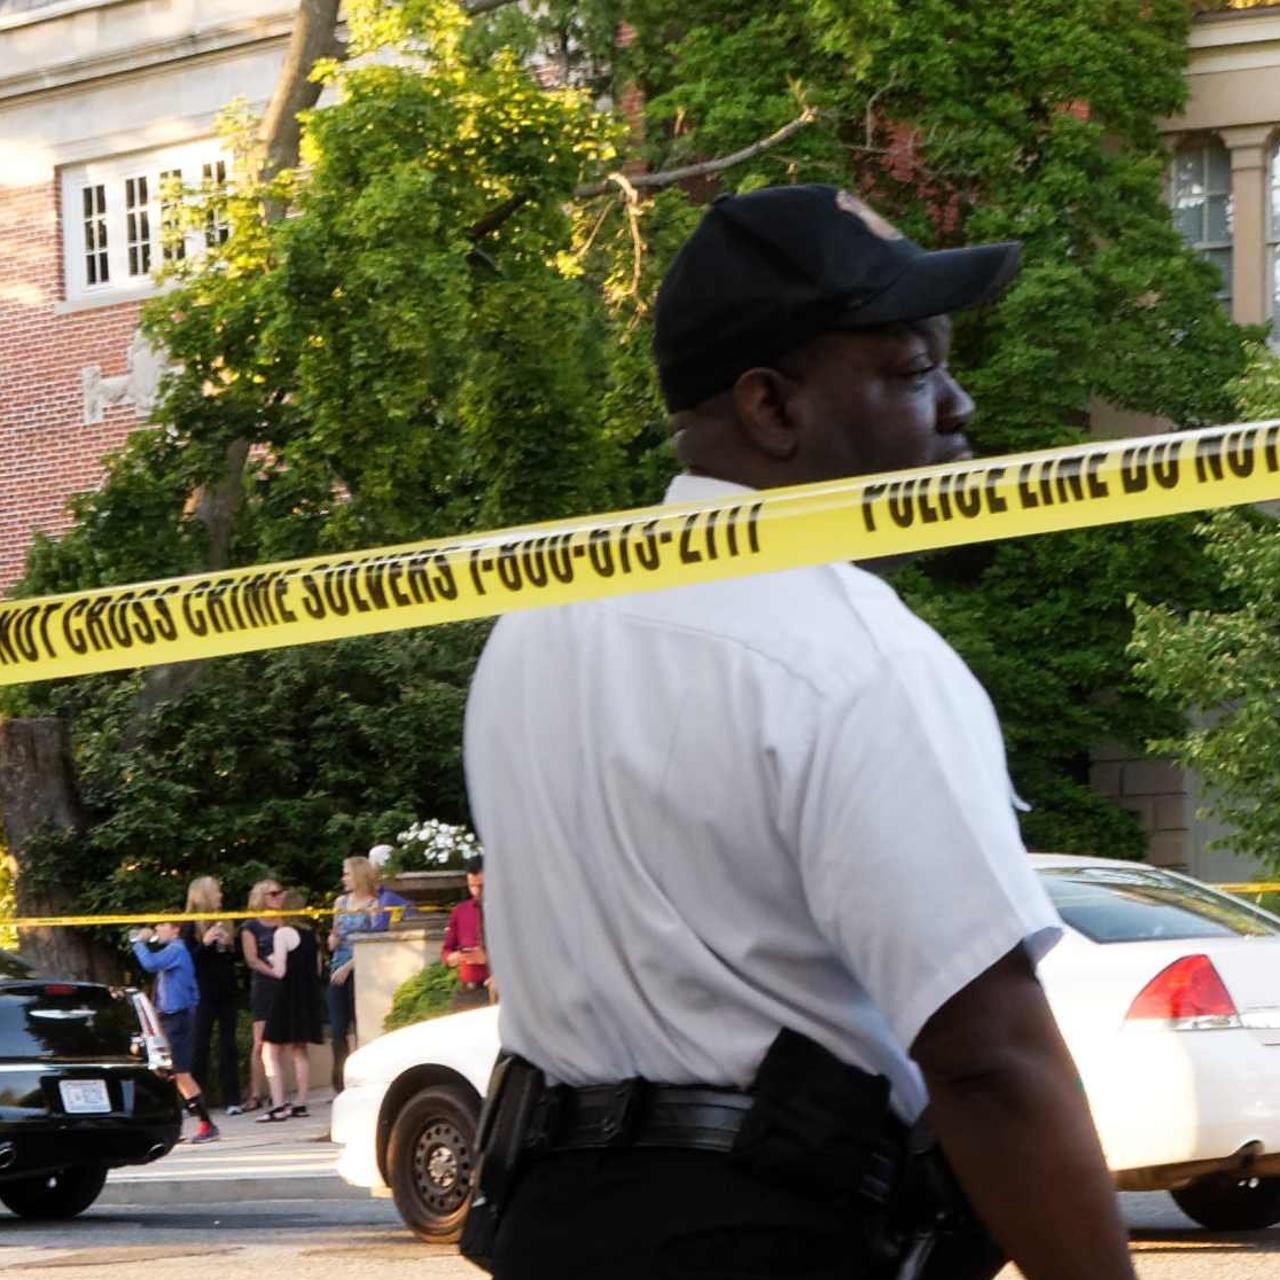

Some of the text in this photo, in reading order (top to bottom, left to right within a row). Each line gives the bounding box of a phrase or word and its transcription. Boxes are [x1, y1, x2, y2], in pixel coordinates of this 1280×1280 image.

[862, 468, 1008, 532] POLICE
[1019, 452, 1109, 509] LINE
[1120, 441, 1182, 493] DO
[1196, 425, 1280, 483] NOT
[63, 585, 178, 655] CROSS
[183, 568, 299, 637] CRIME
[301, 547, 459, 619] SOLVERS
